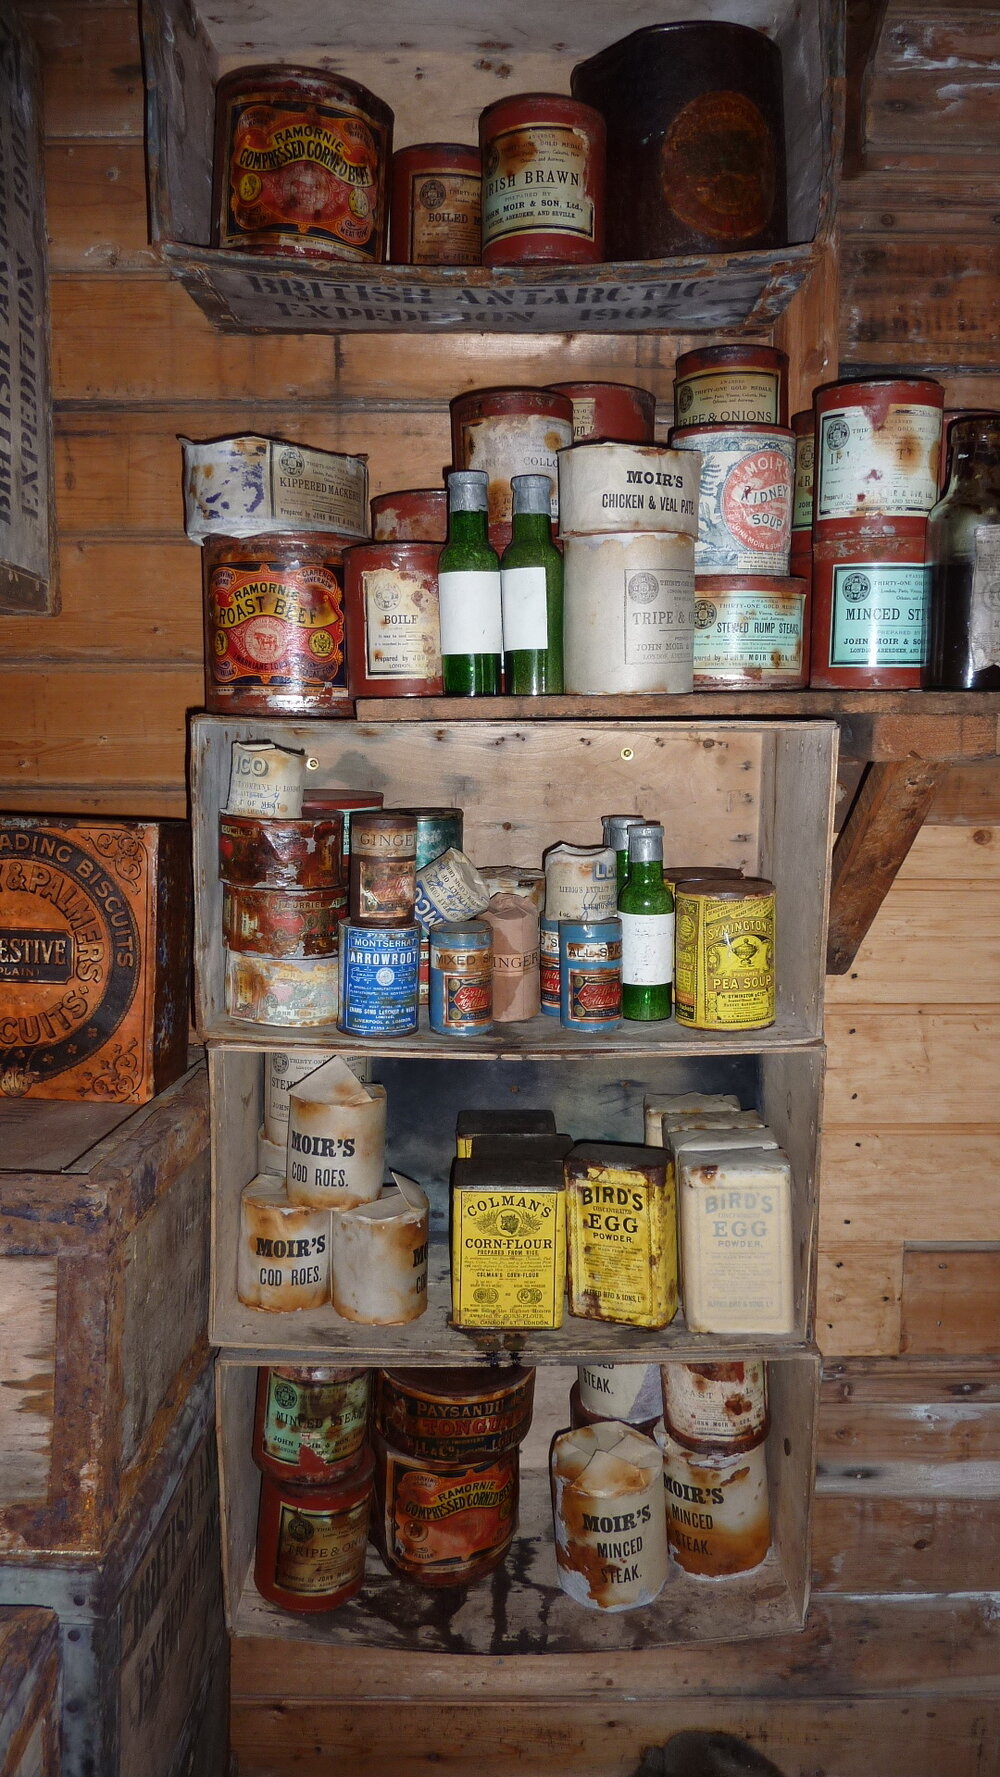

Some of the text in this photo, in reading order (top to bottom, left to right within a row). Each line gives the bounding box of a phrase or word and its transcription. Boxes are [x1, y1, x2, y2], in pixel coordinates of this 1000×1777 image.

[274, 125, 344, 153] RAMORNIE
[239, 140, 305, 169] COMPRESSED
[306, 140, 348, 177] CORNED
[485, 170, 580, 200] IRISH BRAWN
[503, 201, 525, 213] MOIR
[428, 213, 468, 224] BOILED
[246, 275, 712, 306] BRITISH ANTARCTIC
[275, 301, 683, 323] EXPEDIION 1907
[694, 386, 728, 395] THIRTY-ONE
[708, 412, 718, 423] &
[720, 410, 772, 422] ONIONS
[523, 456, 559, 467] COLLO
[745, 457, 790, 480] MOIR'S
[279, 477, 327, 493] KIPPERED
[626, 470, 684, 489] MOIR'S
[602, 493, 645, 510] CHICKEN
[648, 495, 657, 510] &
[660, 496, 678, 513] VEAL
[752, 513, 783, 530] SOUP
[748, 536, 765, 549] MOIR
[234, 582, 300, 601] RAMORNIE
[219, 596, 317, 625] ROAST BEEF
[632, 611, 686, 625] TRIPE &
[845, 608, 900, 621] MINCED
[716, 622, 749, 634] STEWED
[754, 622, 776, 634] RUMP
[636, 643, 662, 651] JOHN
[0, 834, 135, 969] ADING BISCUITS
[6, 862, 104, 984] & PALMERS
[708, 920, 773, 940] SYMINGTON'S
[0, 938, 67, 966] ESTIVE
[354, 938, 415, 948] MONTSERRAT
[350, 951, 417, 965] ARROWROOT
[436, 953, 476, 966] MIXED
[493, 953, 538, 969] INGER
[713, 975, 772, 989] PEA SOUP
[0, 989, 90, 1045] CUITS
[271, 1076, 294, 1090] STEW
[291, 1130, 355, 1158] MOIR'S
[291, 1162, 349, 1188] COD ROES.
[467, 1195, 552, 1218] COLMAN'S
[582, 1186, 643, 1211] BIRD'S
[705, 1191, 773, 1214] BIRD'S
[588, 1213, 639, 1233] EGG
[712, 1220, 768, 1238] EGG
[256, 1234, 326, 1259] MOIR'S
[465, 1238, 553, 1249] CORN-FLOUR
[260, 1265, 322, 1287] COD ROES.
[603, 1290, 615, 1299] BIRD
[616, 1292, 620, 1300] &
[582, 1368, 614, 1395] STEAK.
[416, 1400, 505, 1418] PAYSANDU
[276, 1411, 323, 1430] MINCED
[273, 1435, 294, 1447] JOHN
[437, 1481, 496, 1502] RAMORNIE
[663, 1471, 725, 1505] MOIR'S
[405, 1496, 466, 1520] COMPRESSED
[467, 1491, 499, 1506] CORNED
[582, 1504, 651, 1534] MOIR'S
[671, 1503, 713, 1530] MINCED
[285, 1543, 339, 1558] TRIPE &
[597, 1536, 643, 1559] MINCED
[674, 1531, 713, 1557] STEAK.
[601, 1565, 643, 1584] STEAK.
